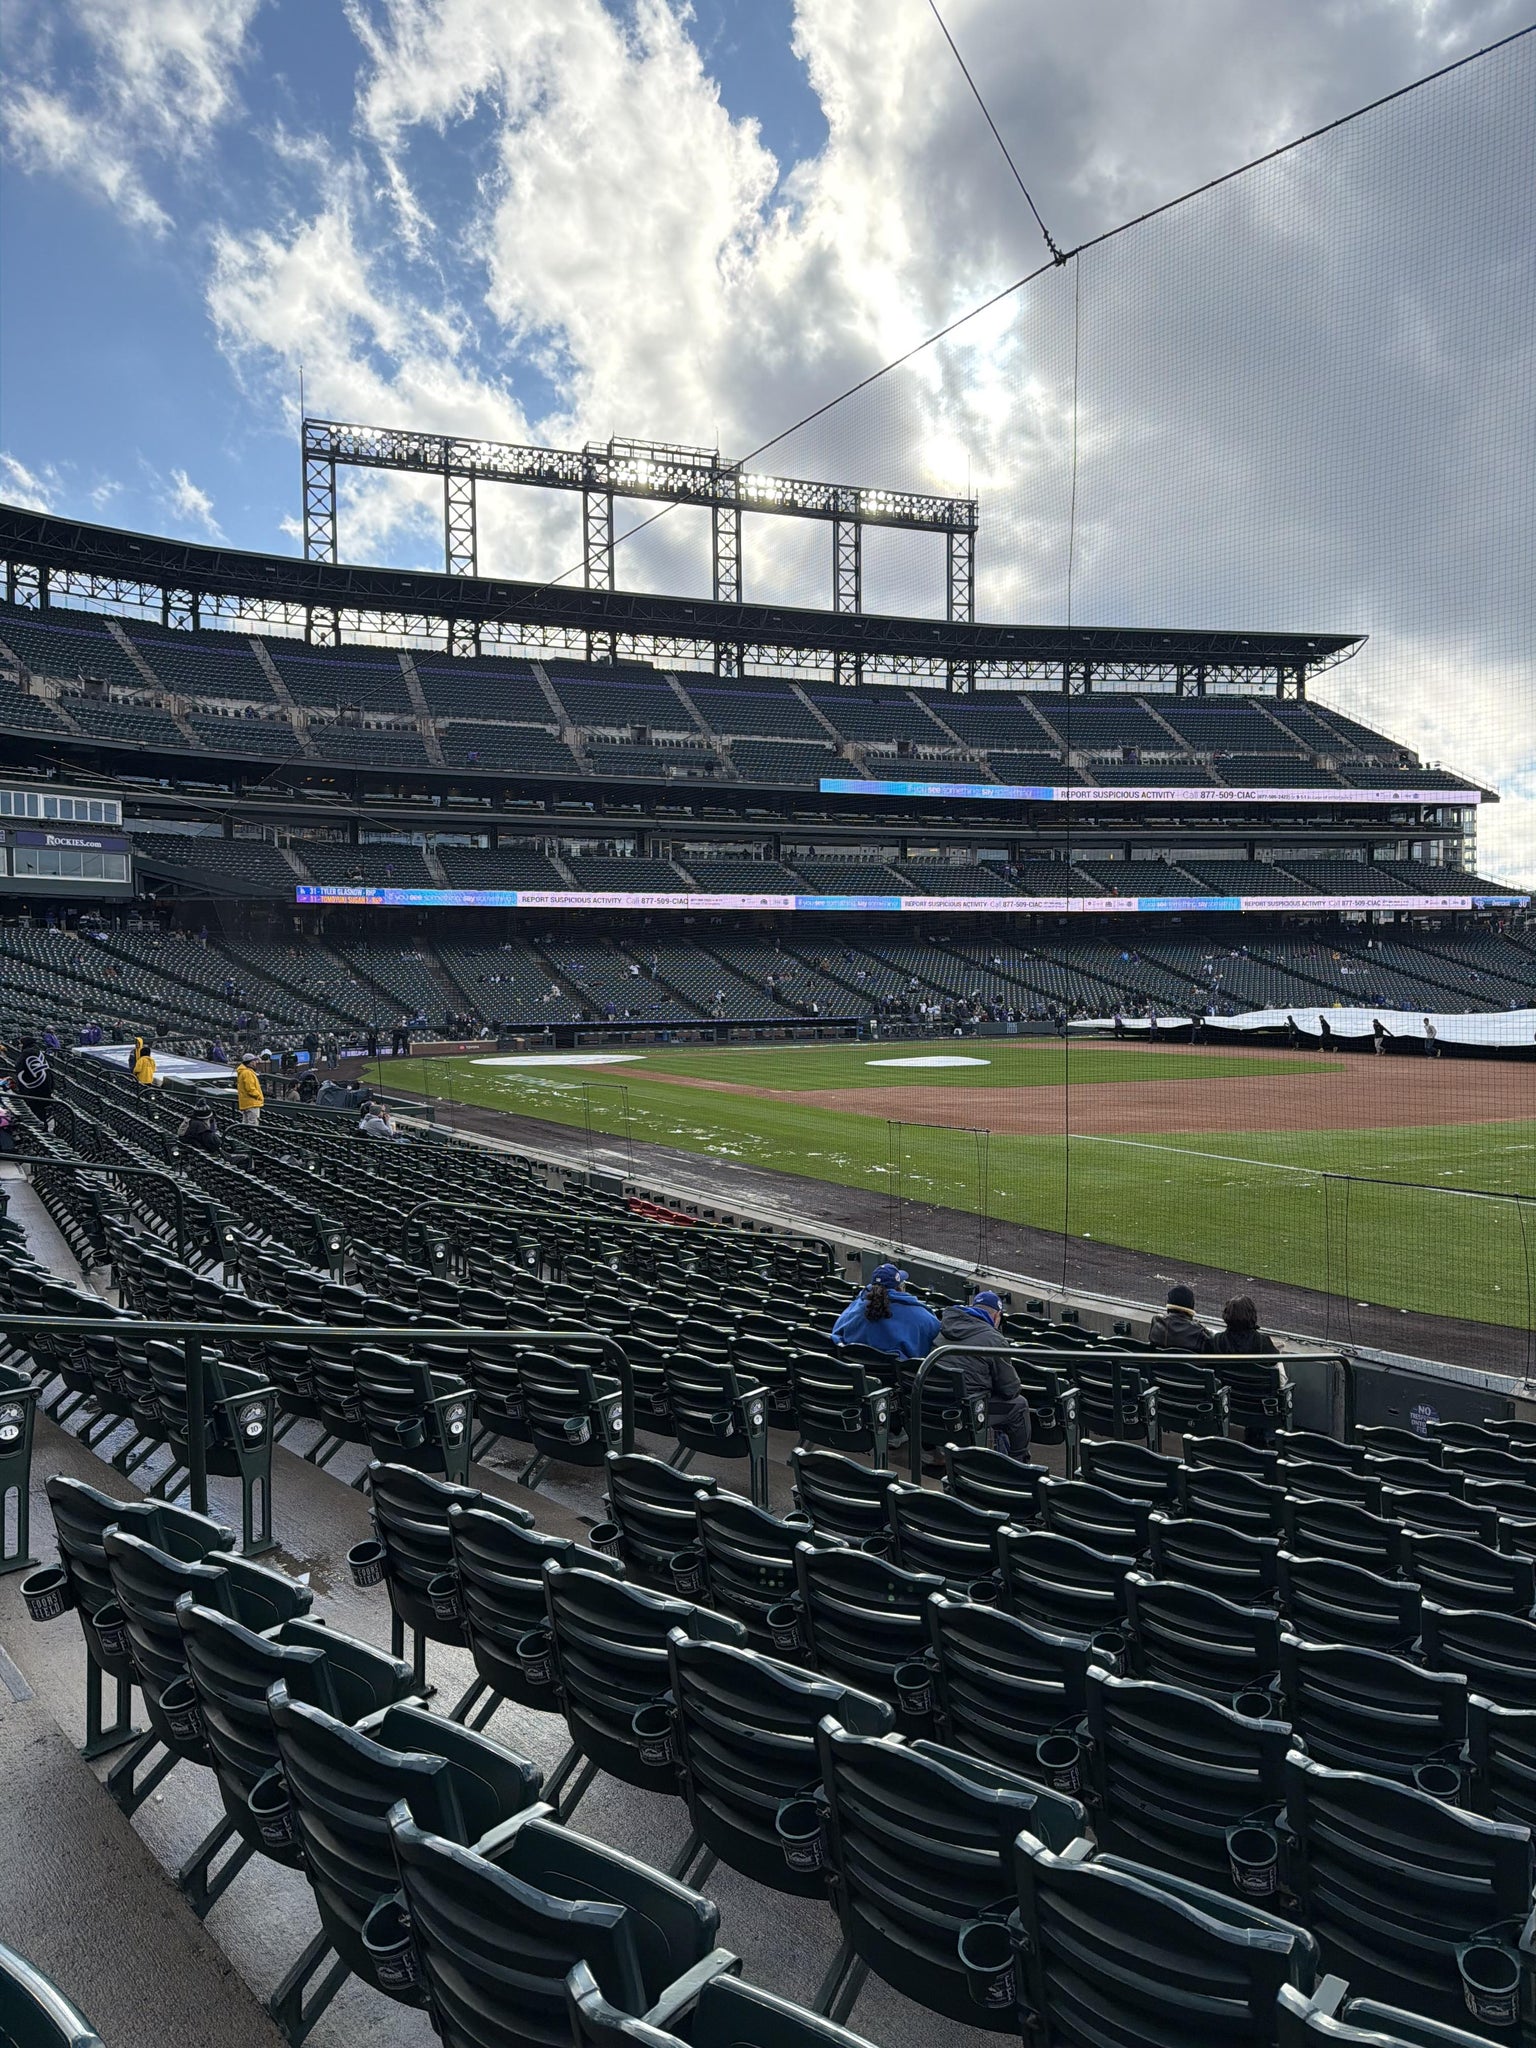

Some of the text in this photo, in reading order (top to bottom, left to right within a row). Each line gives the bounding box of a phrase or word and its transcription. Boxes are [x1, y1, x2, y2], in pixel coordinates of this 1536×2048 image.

[981, 788, 994, 797] say
[1061, 790, 1175, 799] REPORT SUSPICIOUS ACTIVITY
[1182, 791, 1199, 799] Call
[1200, 791, 1257, 799] 877-509-CIAC
[45, 834, 102, 848] ROCKIES.com
[641, 897, 689, 905] 877-509-CIAC
[1418, 1404, 1432, 1416] NO
[250, 1424, 259, 1433] 10
[357, 1564, 379, 1578] COORS
[359, 1571, 381, 1585] FIELD
[31, 1593, 58, 1609] COORS
[33, 1602, 61, 1619] FIELD
